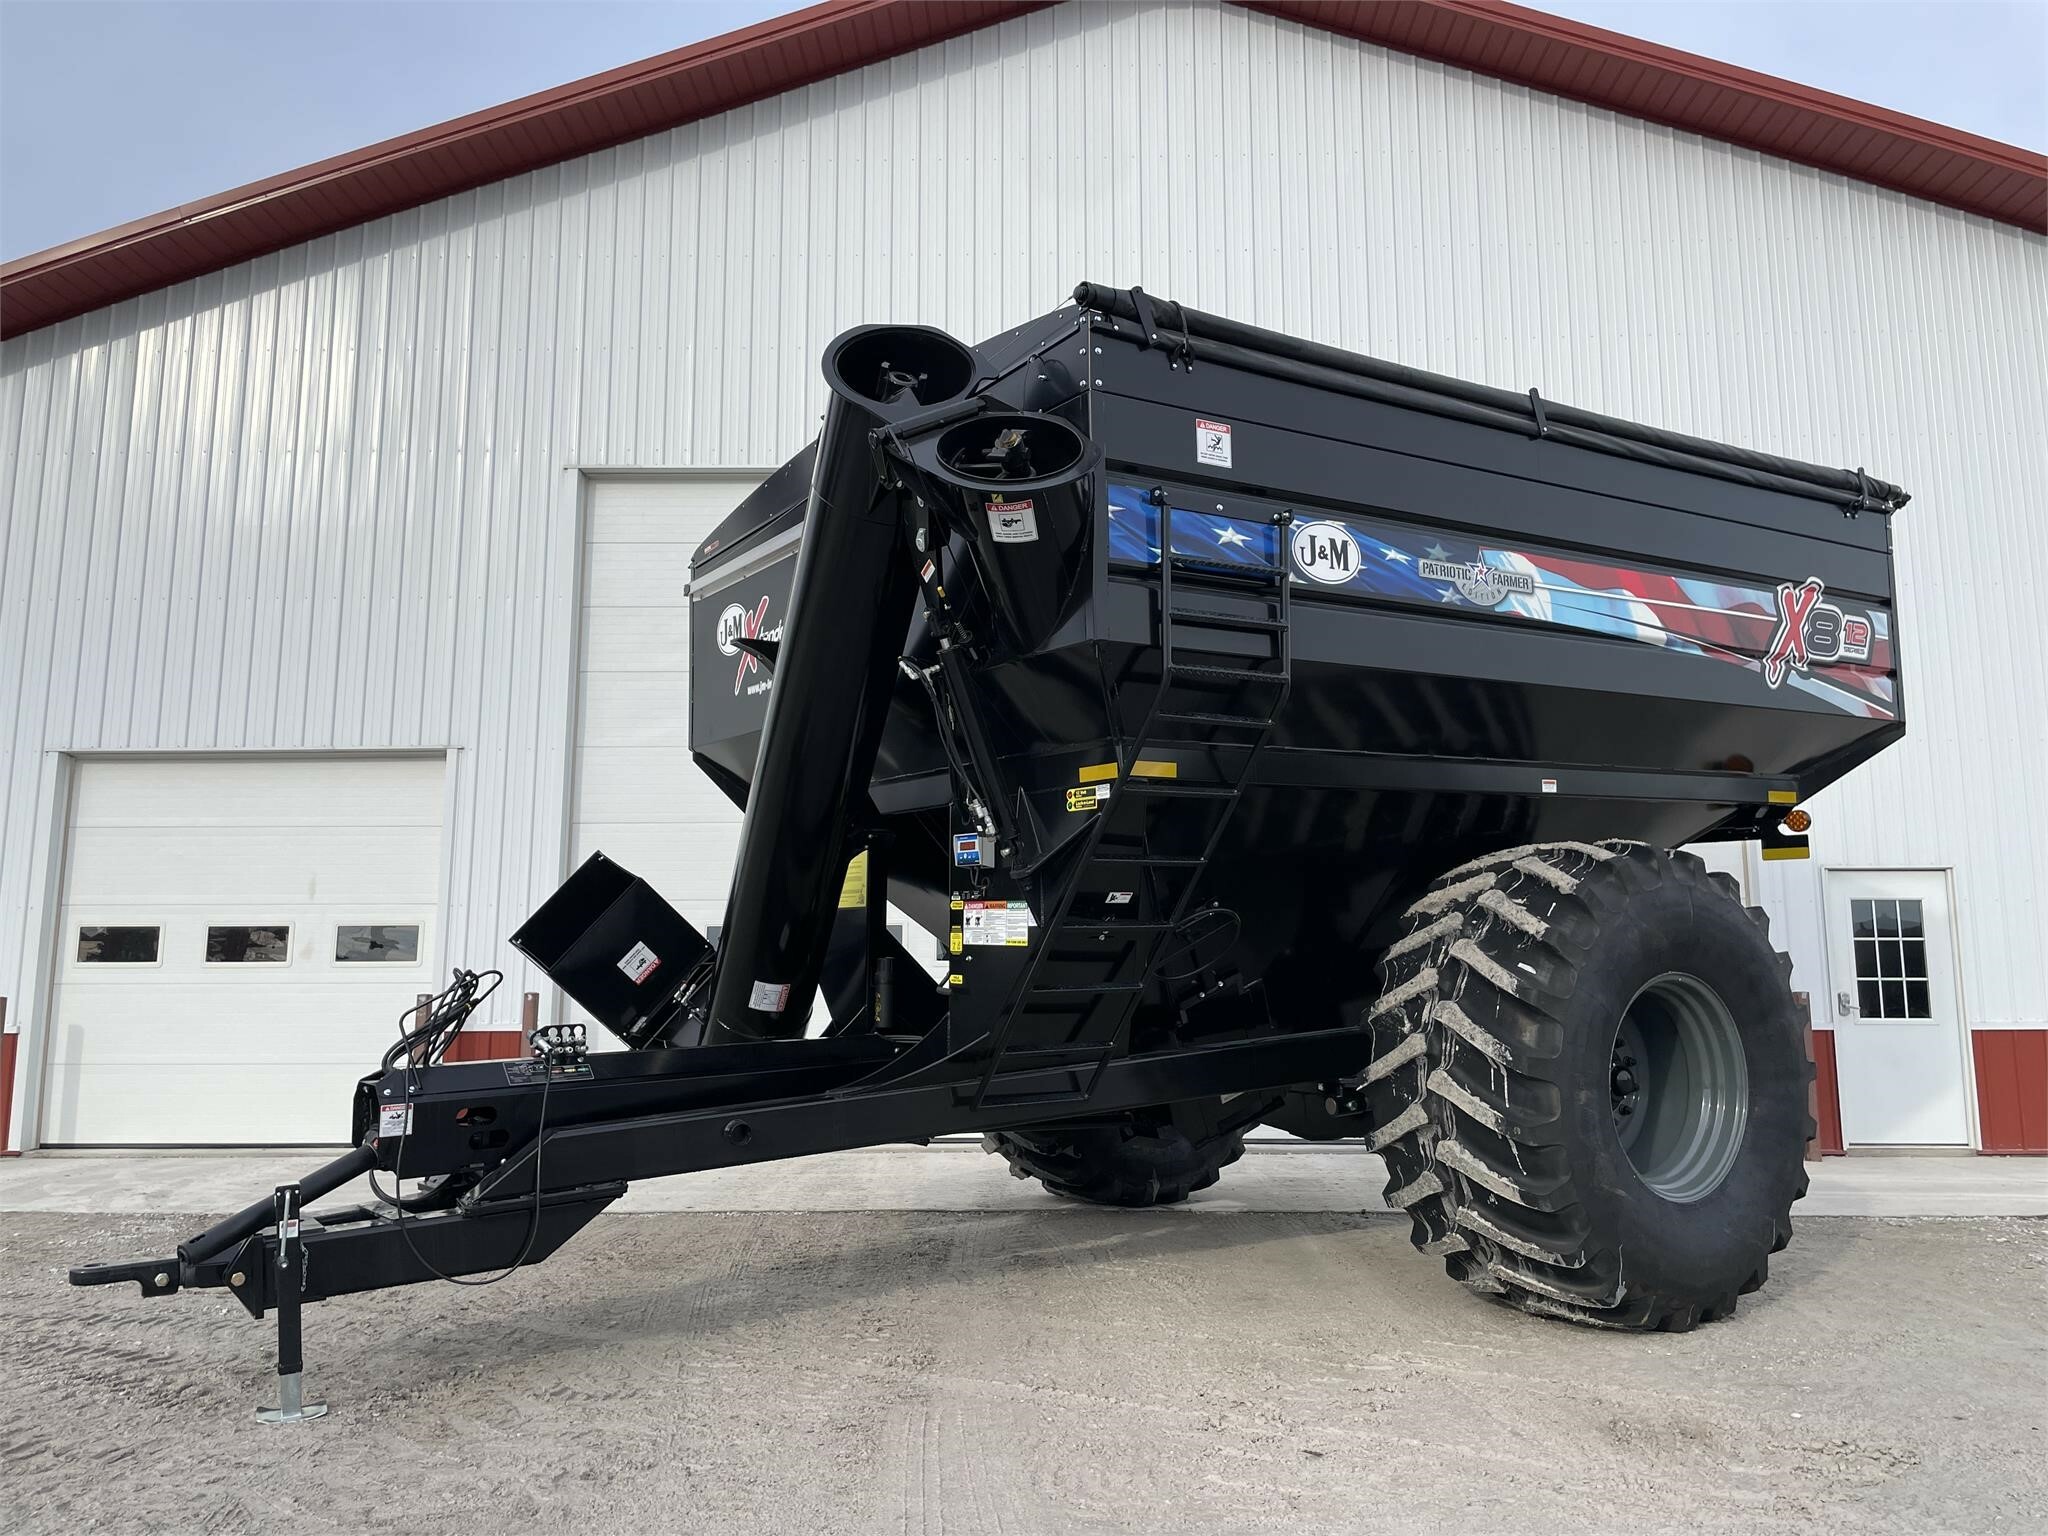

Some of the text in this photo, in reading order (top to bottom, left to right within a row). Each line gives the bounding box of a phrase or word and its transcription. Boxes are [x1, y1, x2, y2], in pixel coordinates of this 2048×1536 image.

[1205, 422, 1228, 432] DANGER
[998, 502, 1028, 511] DANGER
[1299, 534, 1350, 572] J&M
[1422, 561, 1530, 590] PATRIOTIC FARMER
[1461, 583, 1502, 600] EDITION
